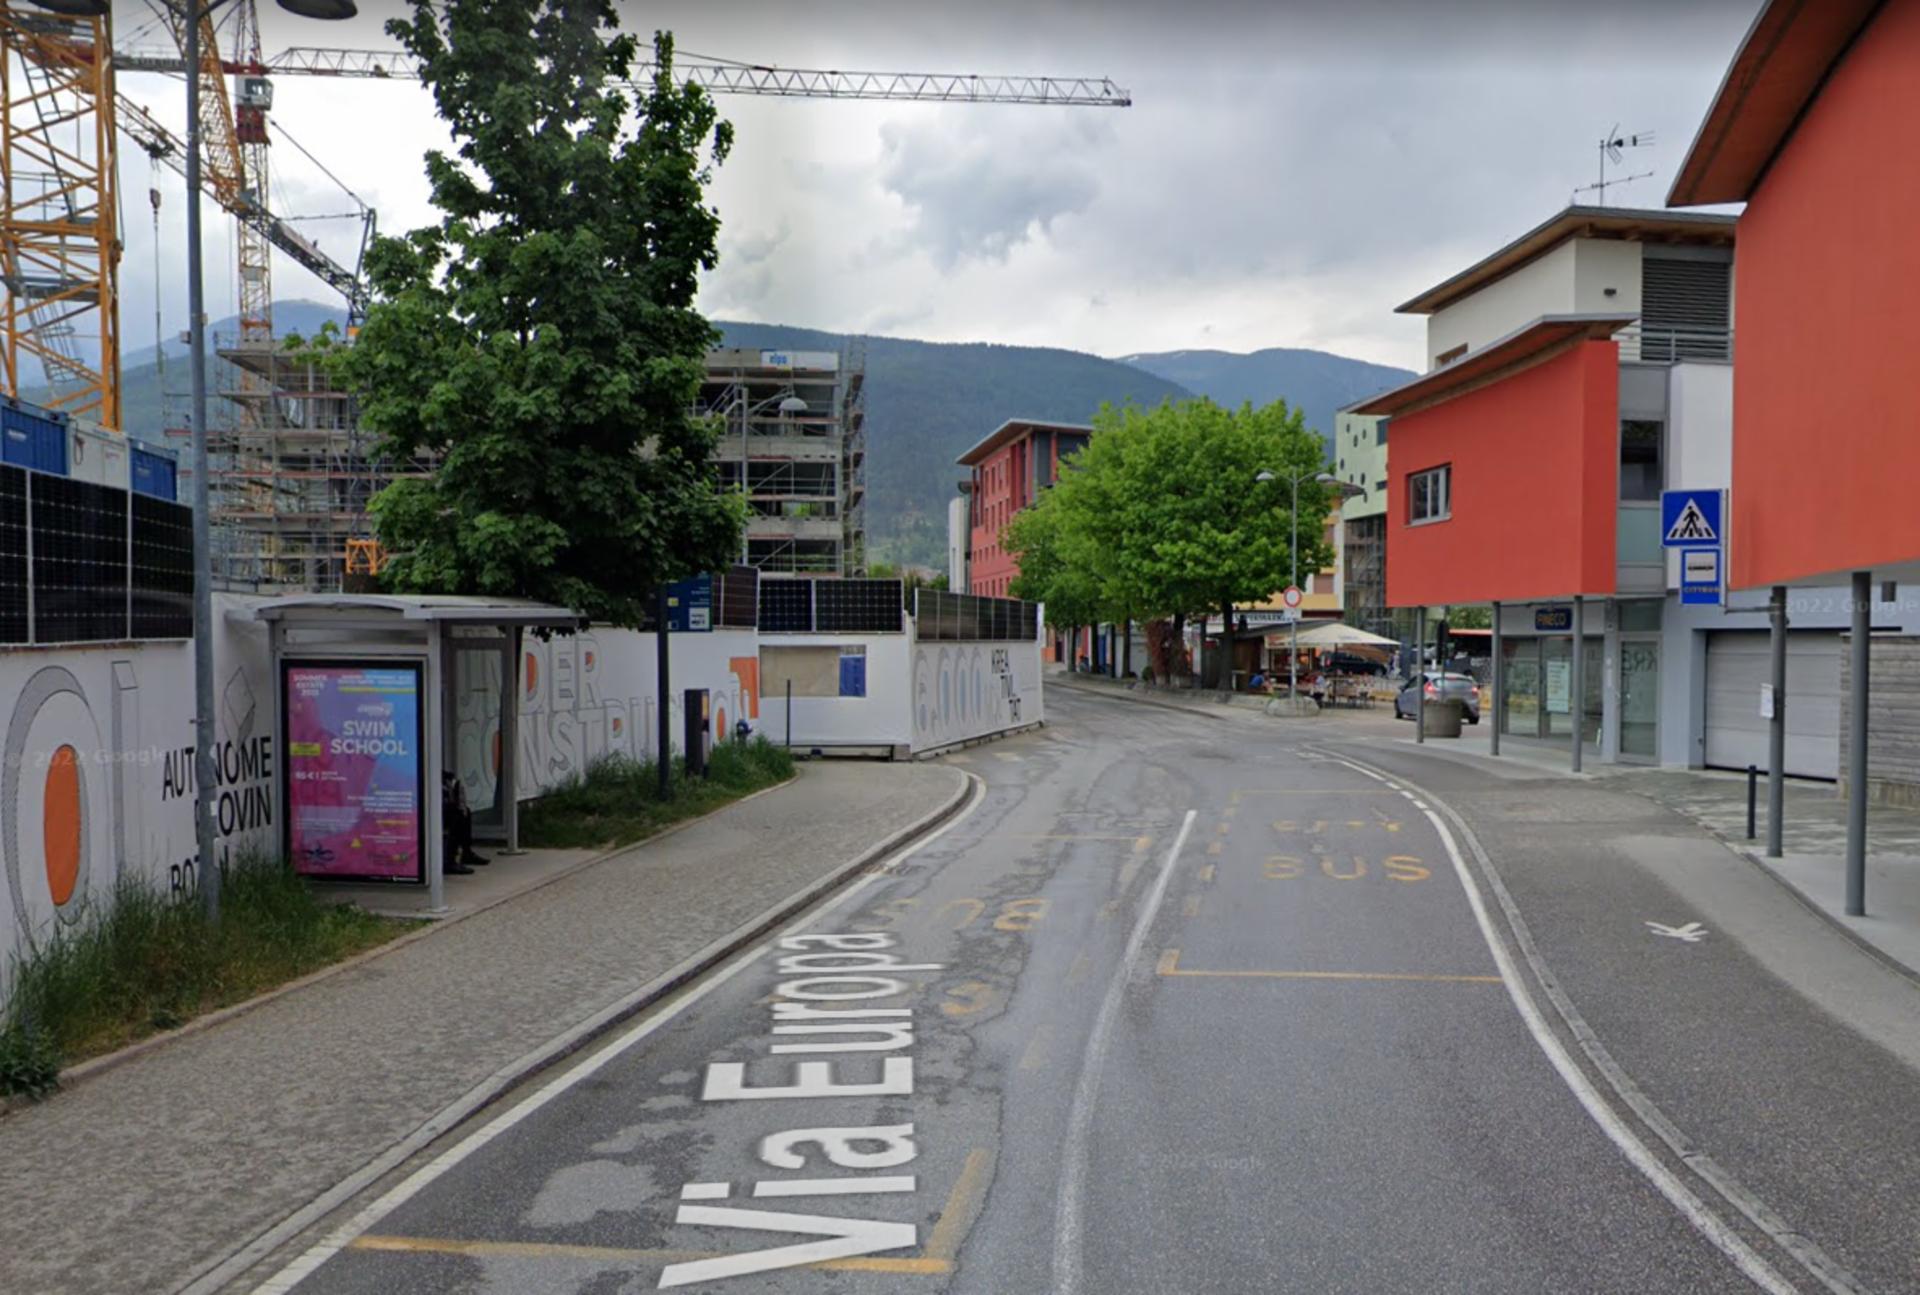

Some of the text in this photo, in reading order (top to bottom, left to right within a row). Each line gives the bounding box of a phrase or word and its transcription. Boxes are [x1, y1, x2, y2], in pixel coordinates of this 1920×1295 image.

[342, 720, 395, 737] SWIM
[330, 738, 407, 756] SCHOOL
[162, 736, 272, 801] AUTNOME
